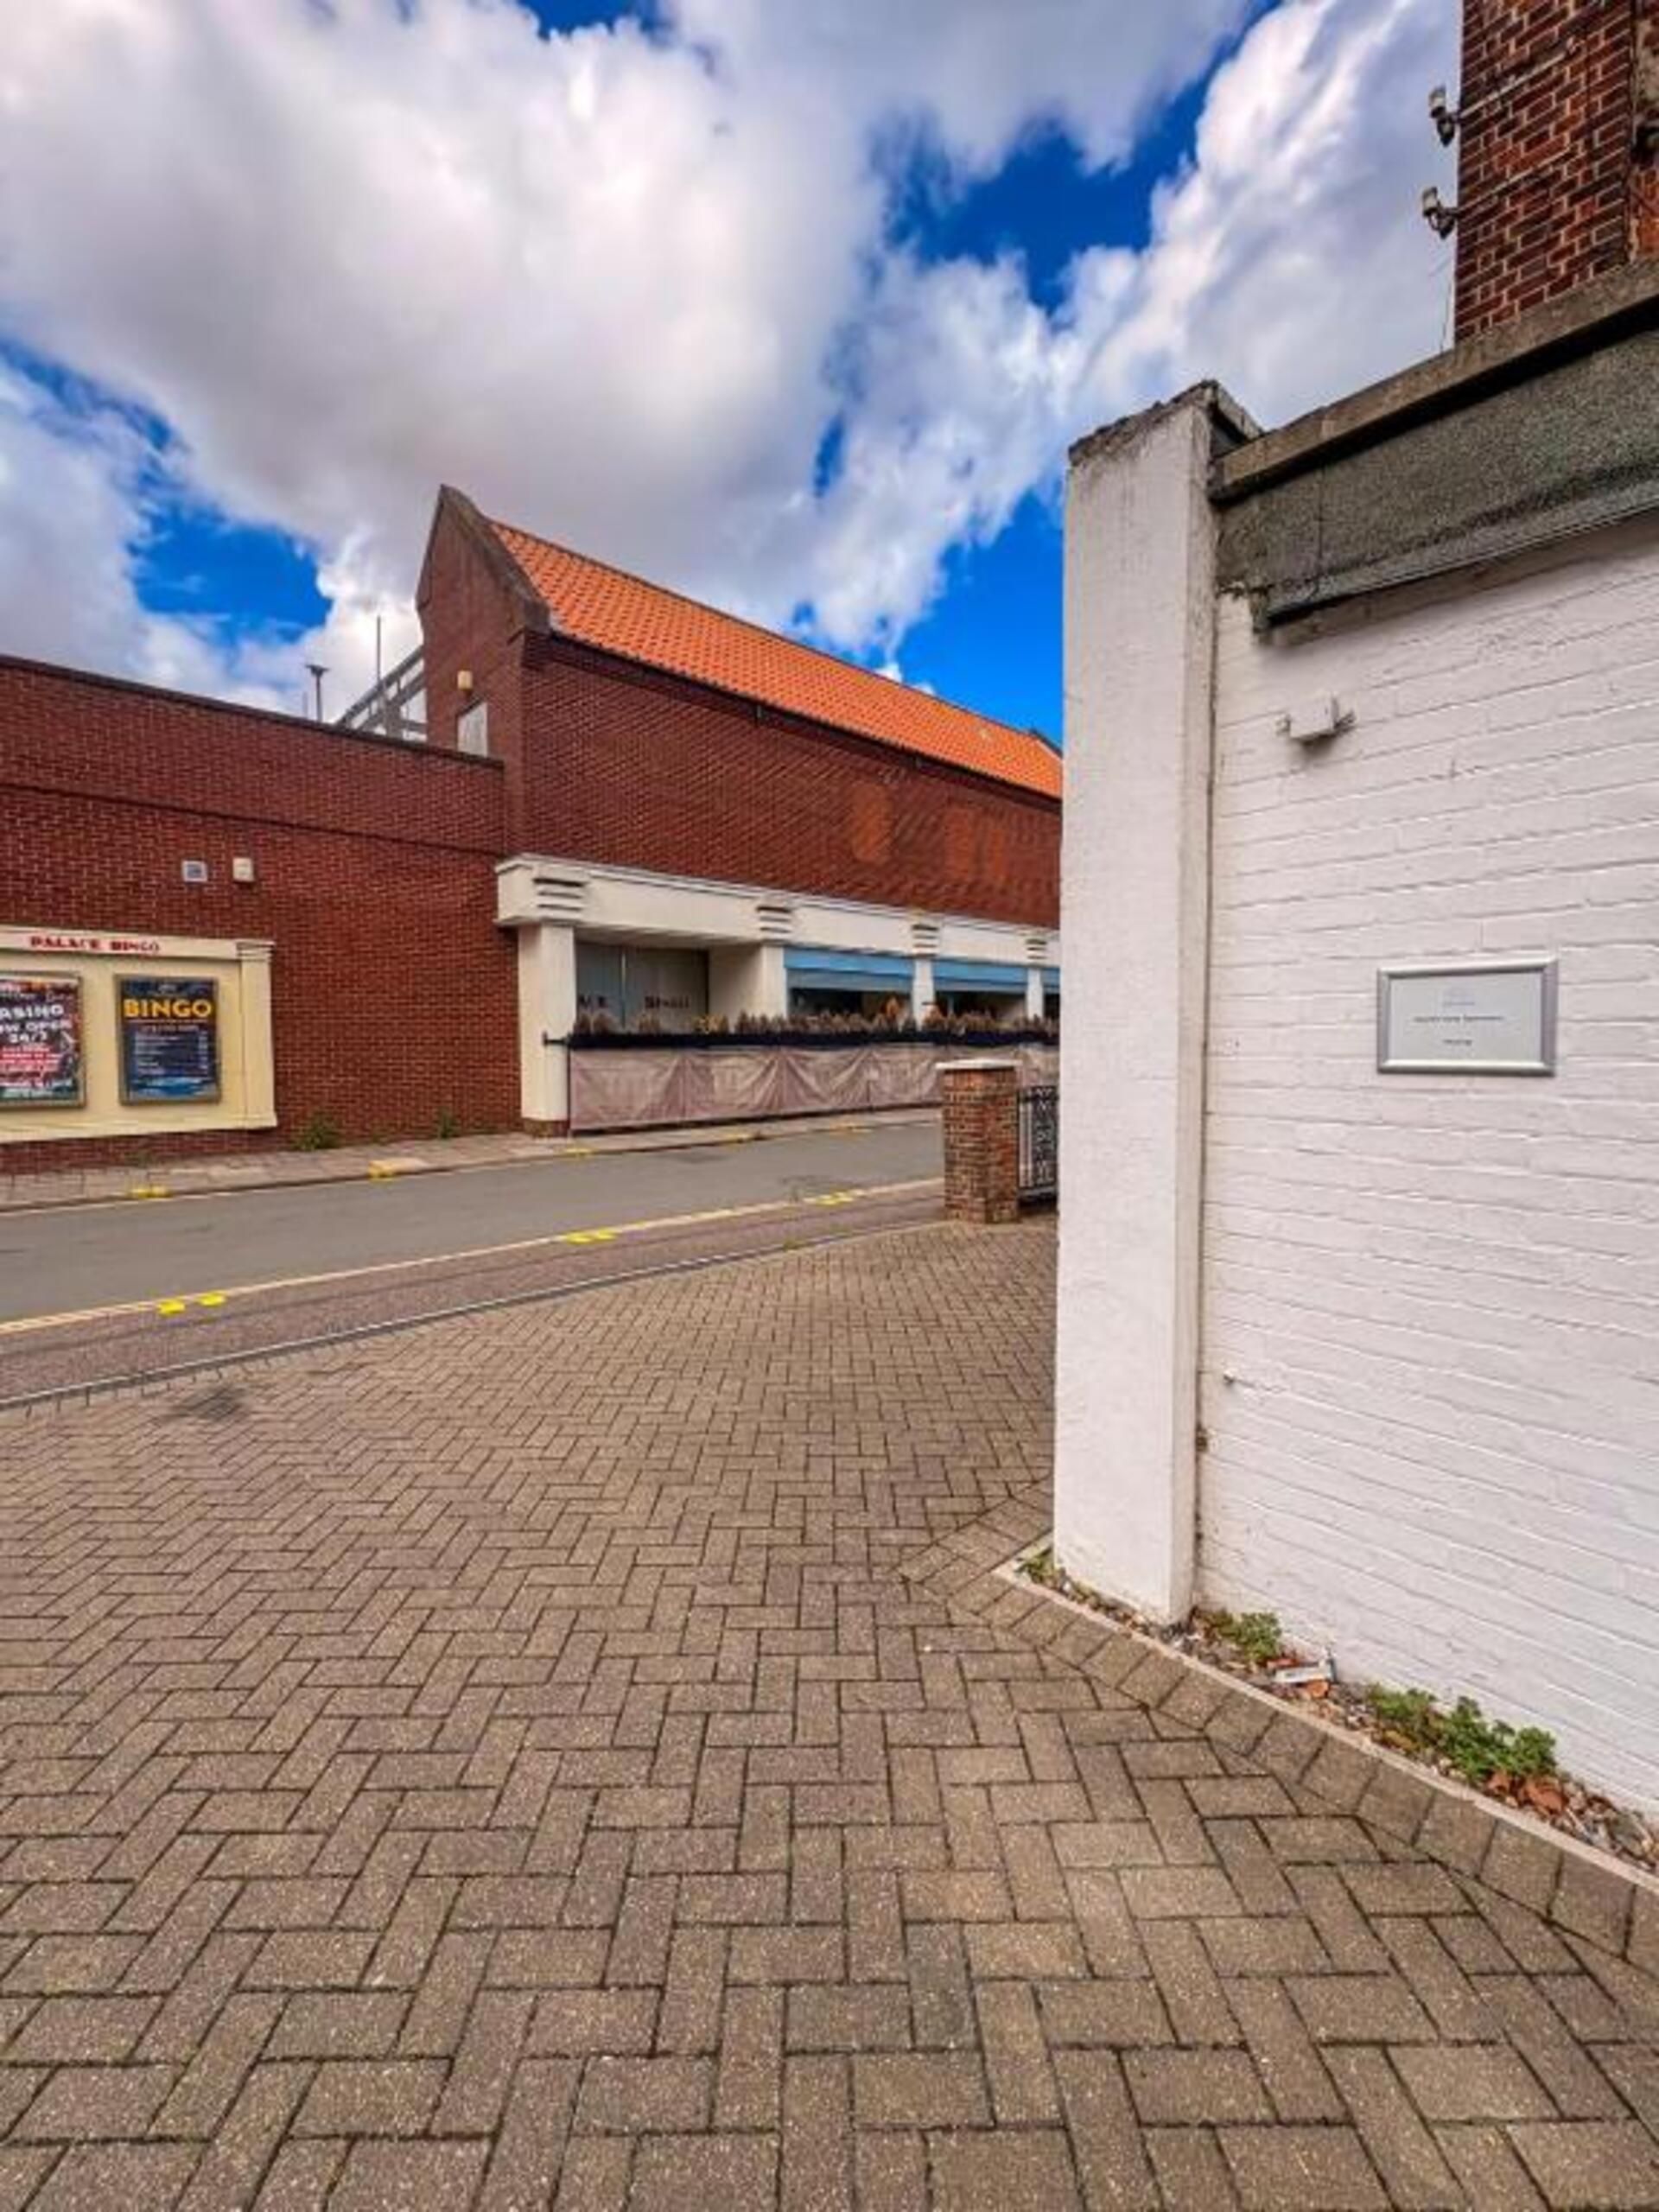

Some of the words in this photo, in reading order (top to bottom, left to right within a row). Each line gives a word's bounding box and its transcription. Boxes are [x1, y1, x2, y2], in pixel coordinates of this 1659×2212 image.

[30, 936, 100, 950] PALACE
[110, 940, 160, 954] BINGO
[0, 1004, 64, 1020] ASINO
[124, 999, 212, 1018] BINGO
